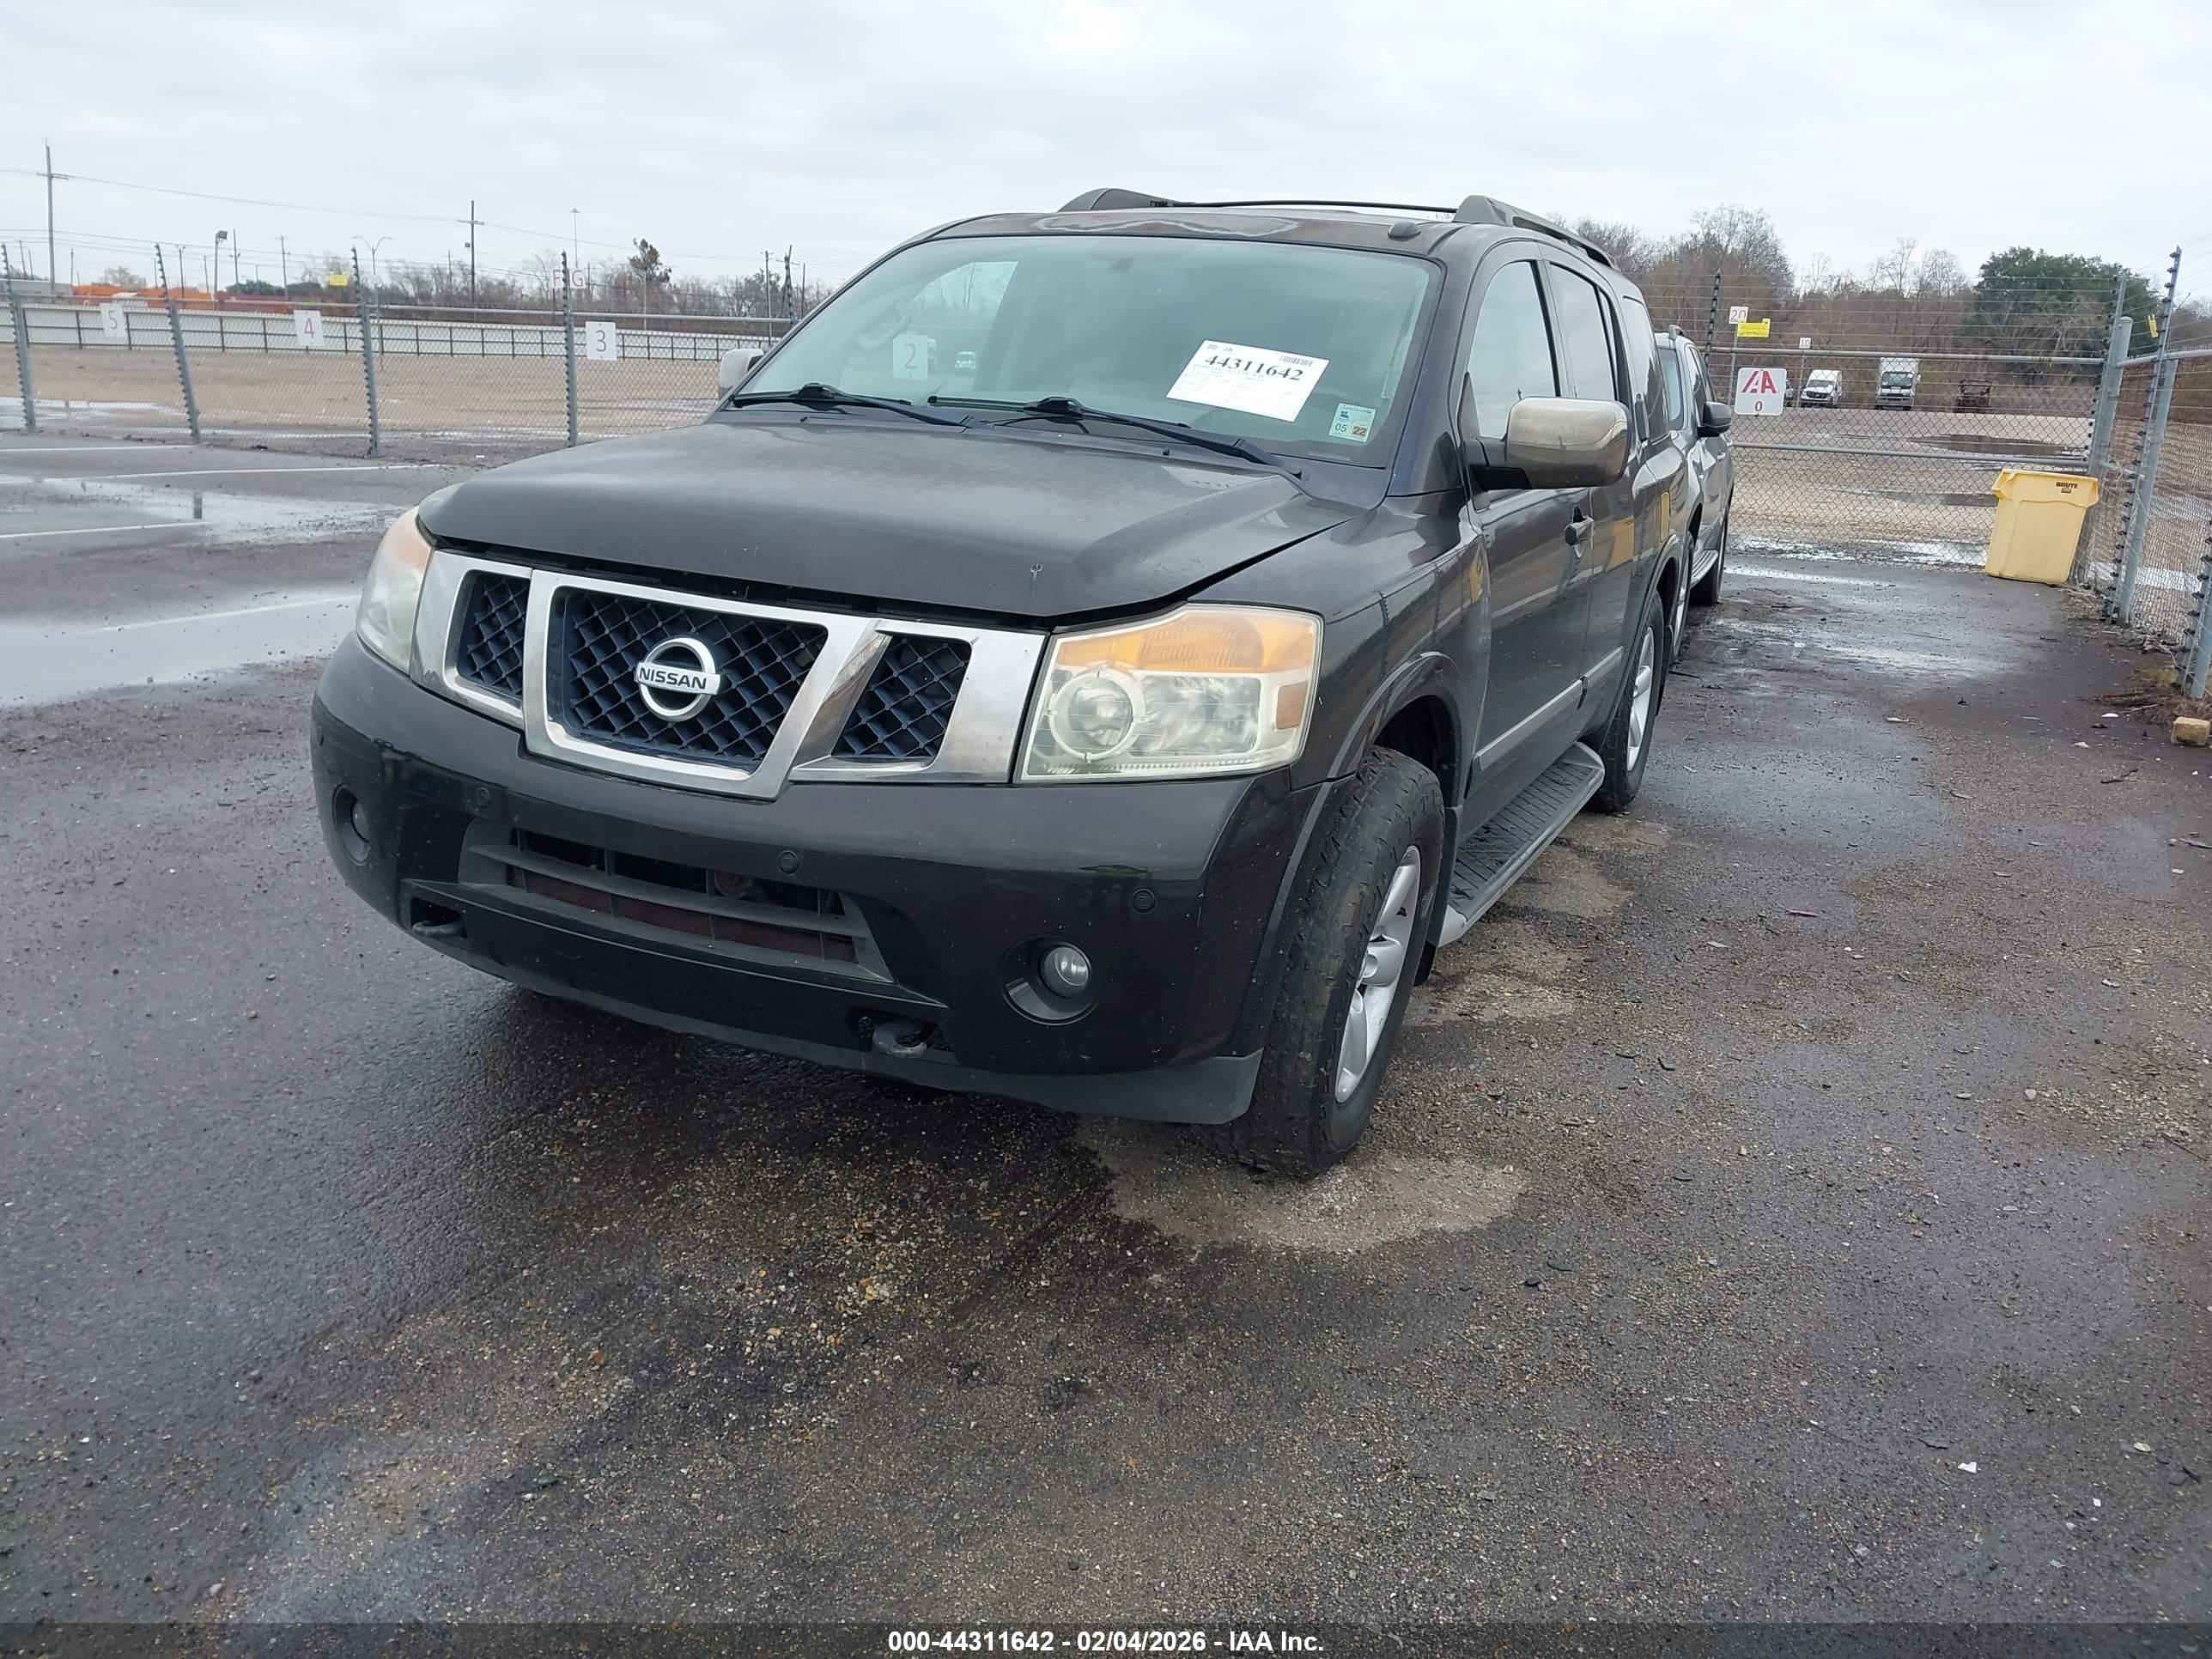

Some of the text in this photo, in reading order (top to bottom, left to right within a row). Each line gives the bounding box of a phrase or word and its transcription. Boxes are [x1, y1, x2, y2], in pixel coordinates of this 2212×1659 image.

[108, 309, 118, 331] 5
[1730, 309, 1747, 323] 20
[303, 317, 315, 339] 4
[595, 329, 607, 352] 3
[904, 343, 918, 369] 2
[1205, 355, 1304, 381] 44311642
[1754, 400, 1763, 412] 0
[1334, 422, 1367, 437] 05 22
[639, 666, 708, 690] NISSAN
